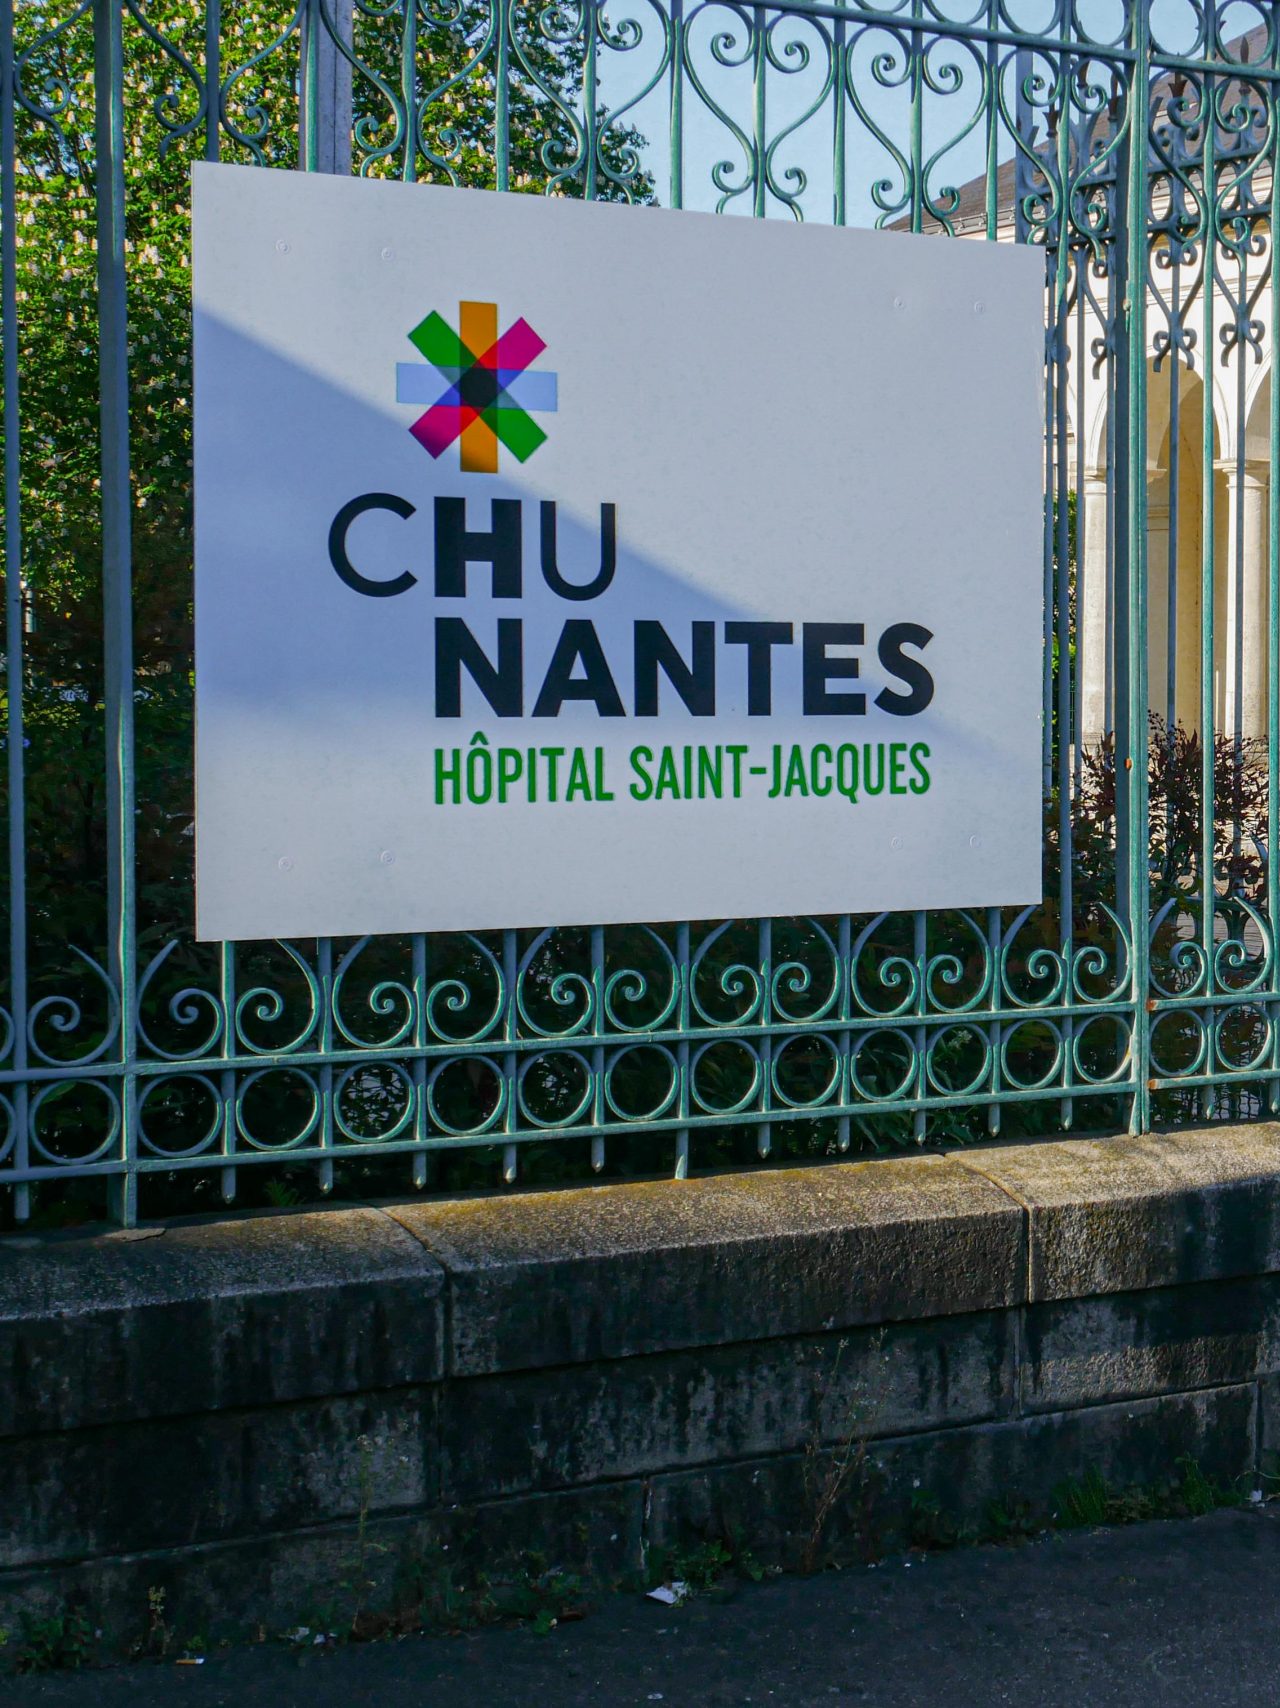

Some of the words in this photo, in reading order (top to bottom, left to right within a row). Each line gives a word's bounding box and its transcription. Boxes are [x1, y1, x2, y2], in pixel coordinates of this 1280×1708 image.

[328, 493, 616, 601] CHU
[435, 617, 934, 717] NANTES
[434, 731, 614, 805] HÔPITAL
[630, 742, 931, 804] SAINT-JACQUES
